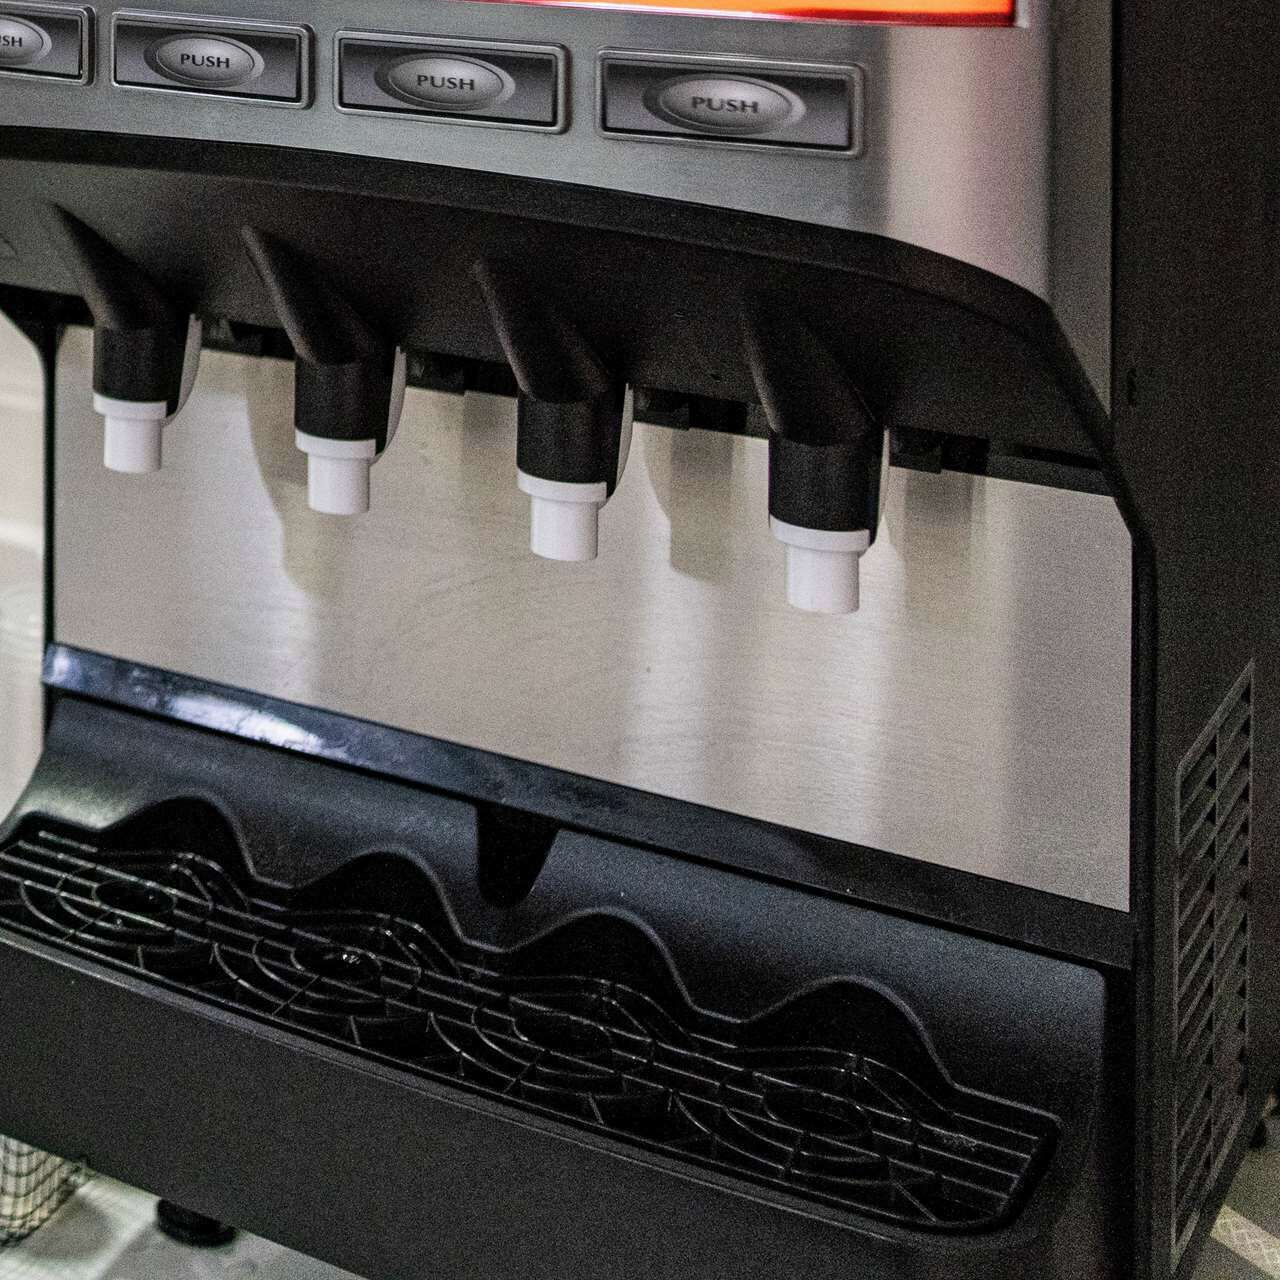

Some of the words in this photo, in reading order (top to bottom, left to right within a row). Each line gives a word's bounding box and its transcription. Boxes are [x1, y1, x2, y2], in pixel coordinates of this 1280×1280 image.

[180, 54, 230, 69] PUSH
[417, 74, 475, 91] PUSH
[691, 96, 758, 114] PUSH
